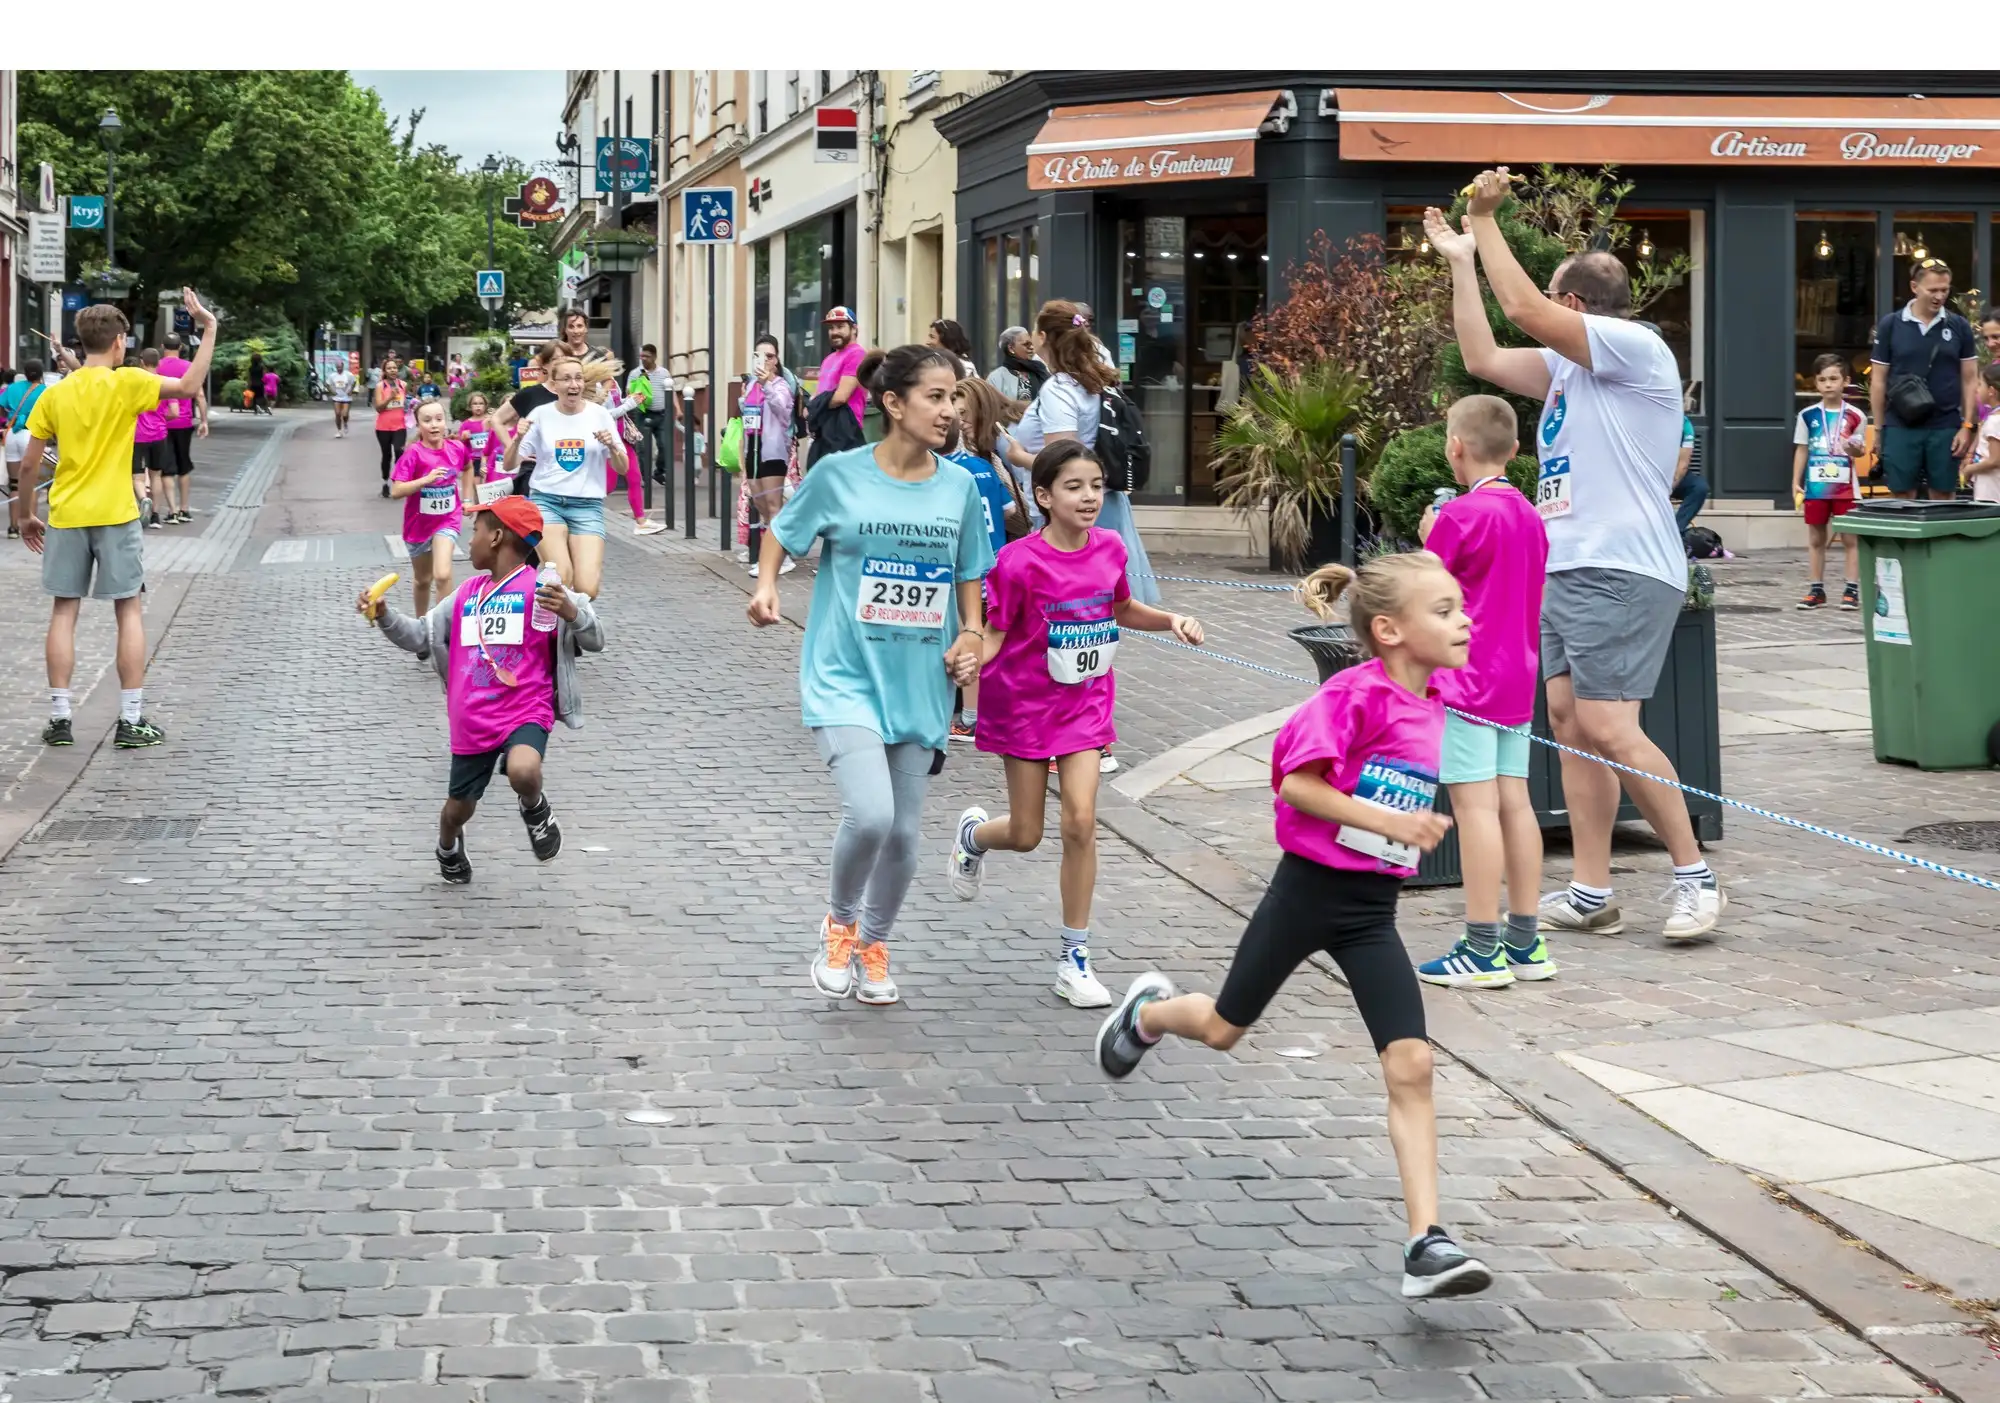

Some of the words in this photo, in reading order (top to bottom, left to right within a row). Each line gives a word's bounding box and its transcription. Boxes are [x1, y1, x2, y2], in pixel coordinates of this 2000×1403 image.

[1710, 130, 1808, 157] Artisan
[1840, 131, 1983, 164] Boulanger
[1044, 155, 1119, 184] L'Etoile
[1124, 156, 1145, 177] de
[1150, 150, 1234, 178] Fontenay
[73, 205, 100, 219] Krys
[717, 225, 728, 233] 20
[561, 448, 580, 457] FAR
[430, 498, 450, 511] 418
[859, 521, 873, 536] LA
[871, 581, 939, 608] 2397
[483, 616, 507, 636] 29
[1048, 622, 1061, 635] LA
[1076, 648, 1100, 674] 90
[1361, 763, 1383, 781] LA
